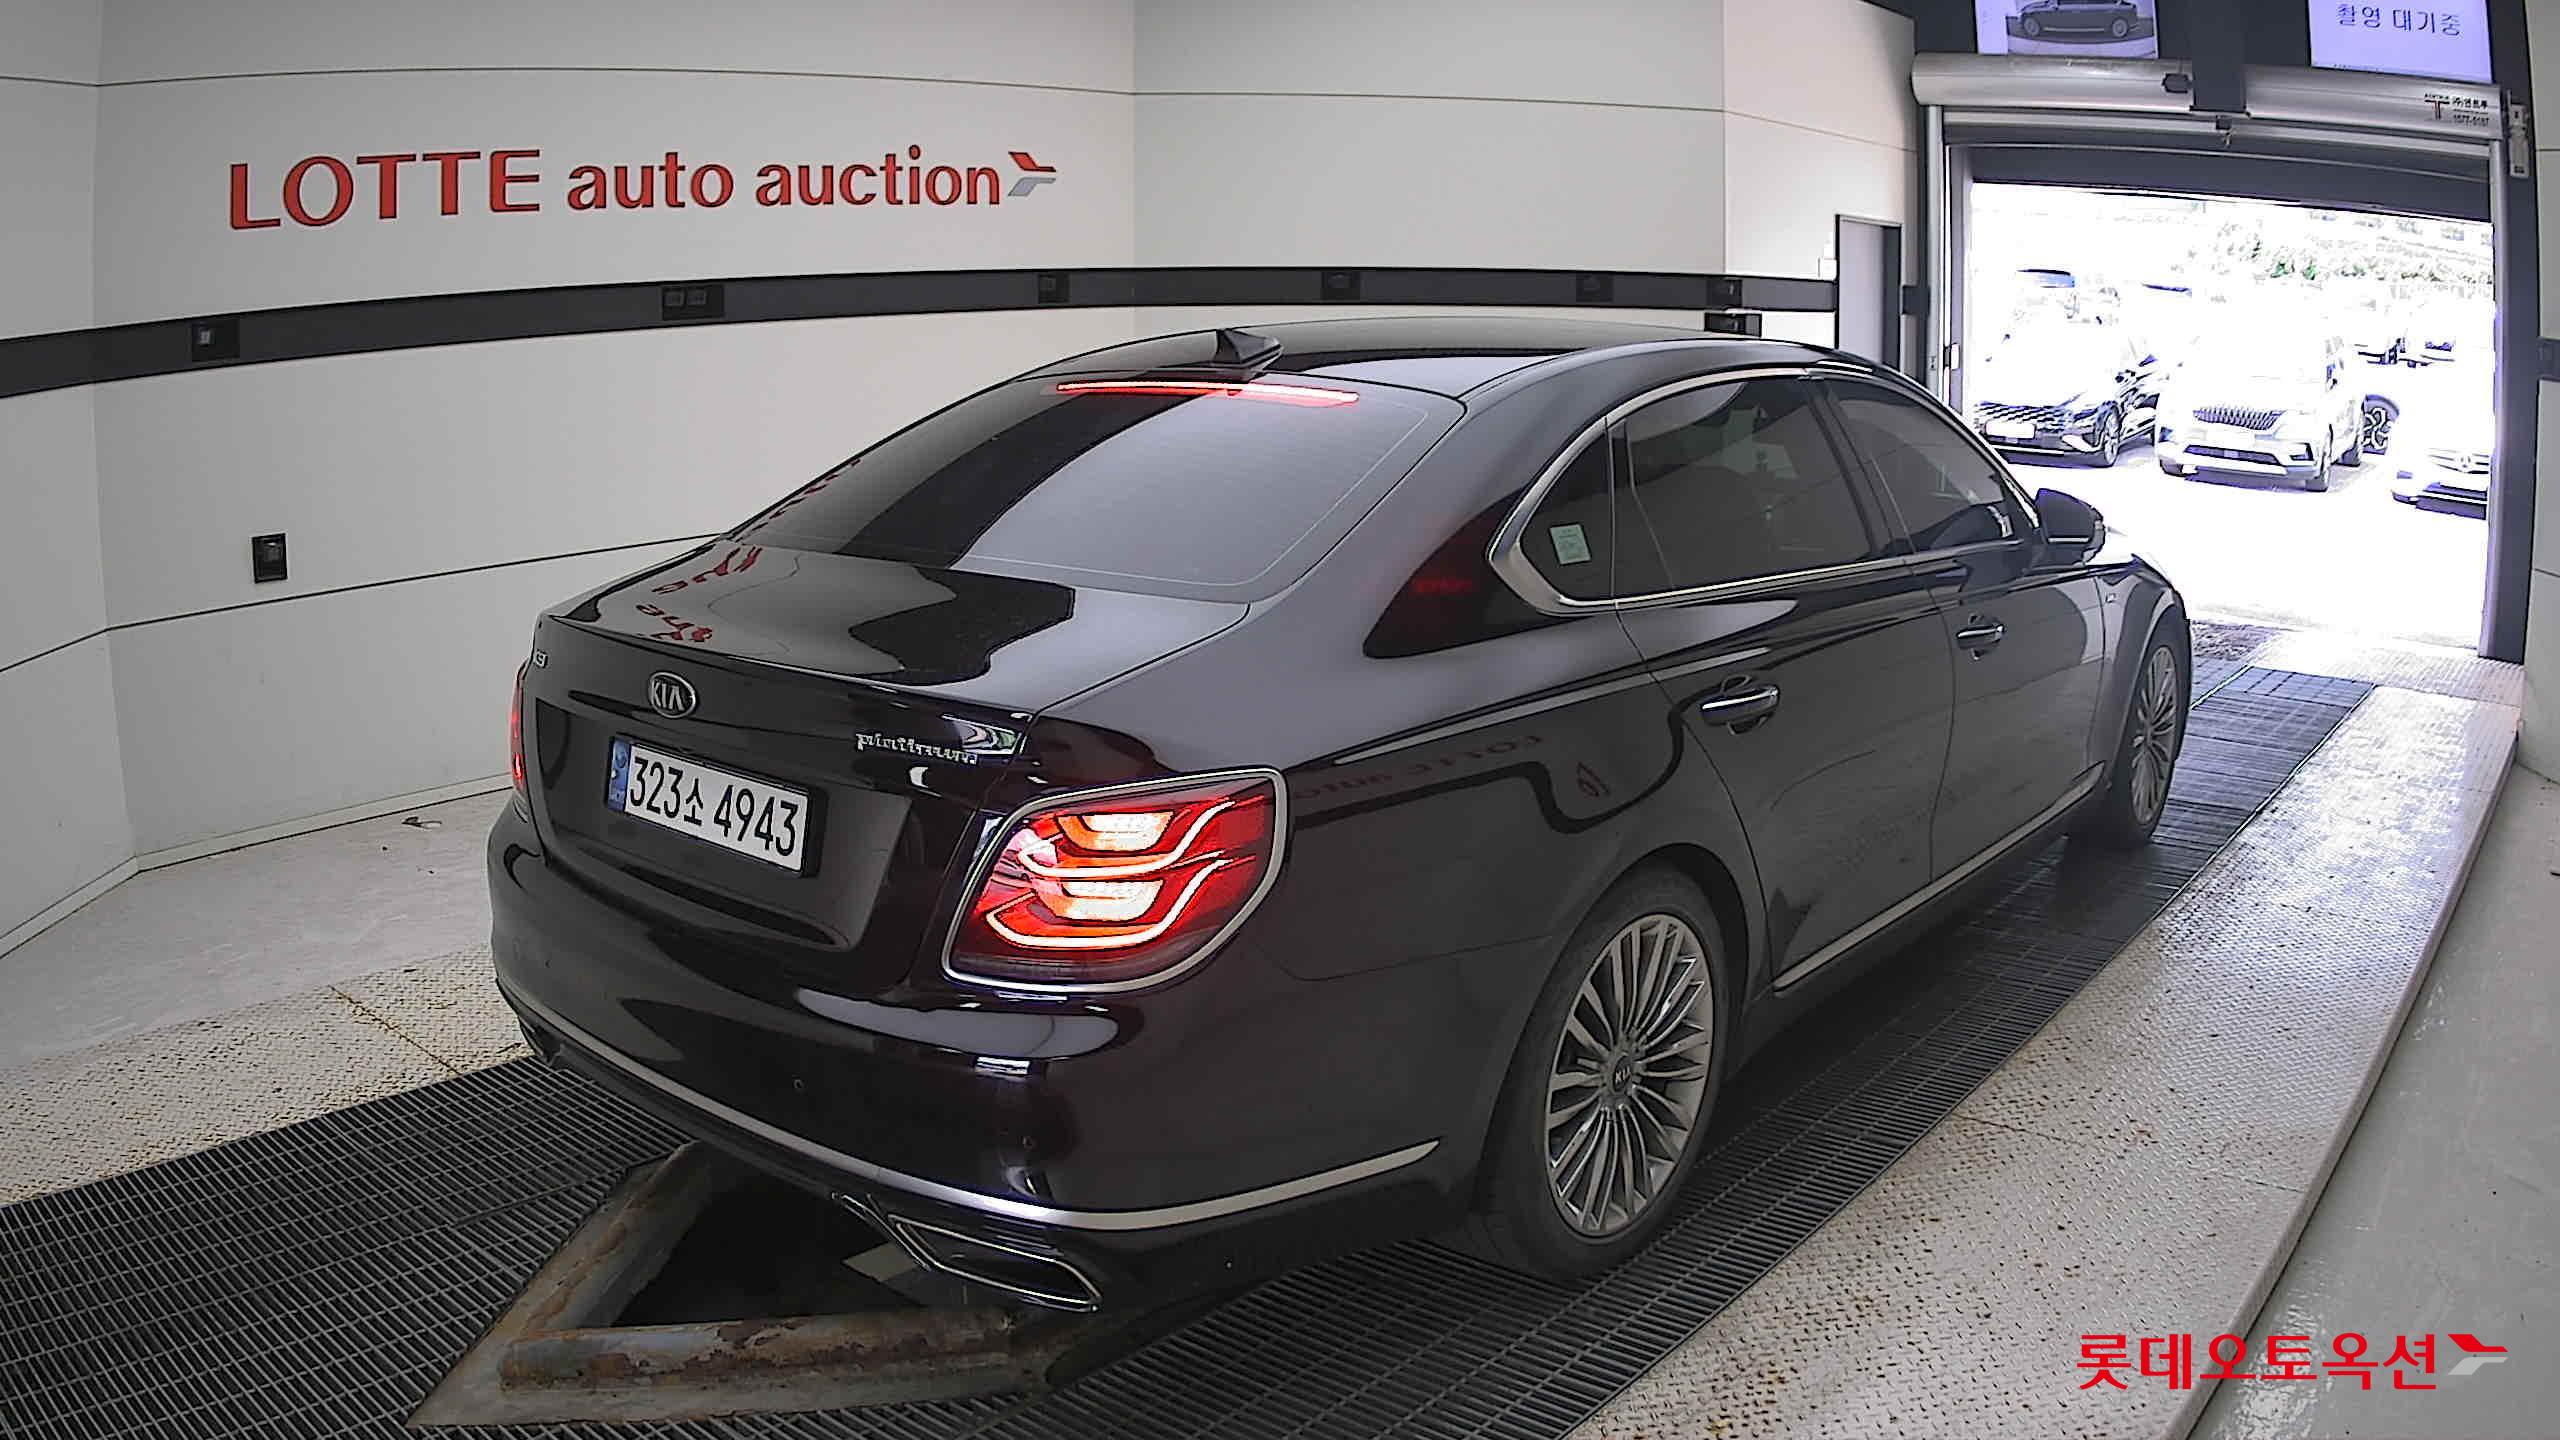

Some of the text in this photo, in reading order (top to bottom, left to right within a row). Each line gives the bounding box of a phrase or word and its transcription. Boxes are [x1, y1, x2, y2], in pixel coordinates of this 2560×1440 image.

[2392, 8, 2460, 36] 대기중
[229, 144, 1001, 231] LOTTE auto auction
[651, 678, 685, 712] KIA
[630, 756, 799, 857] 323소 4943
